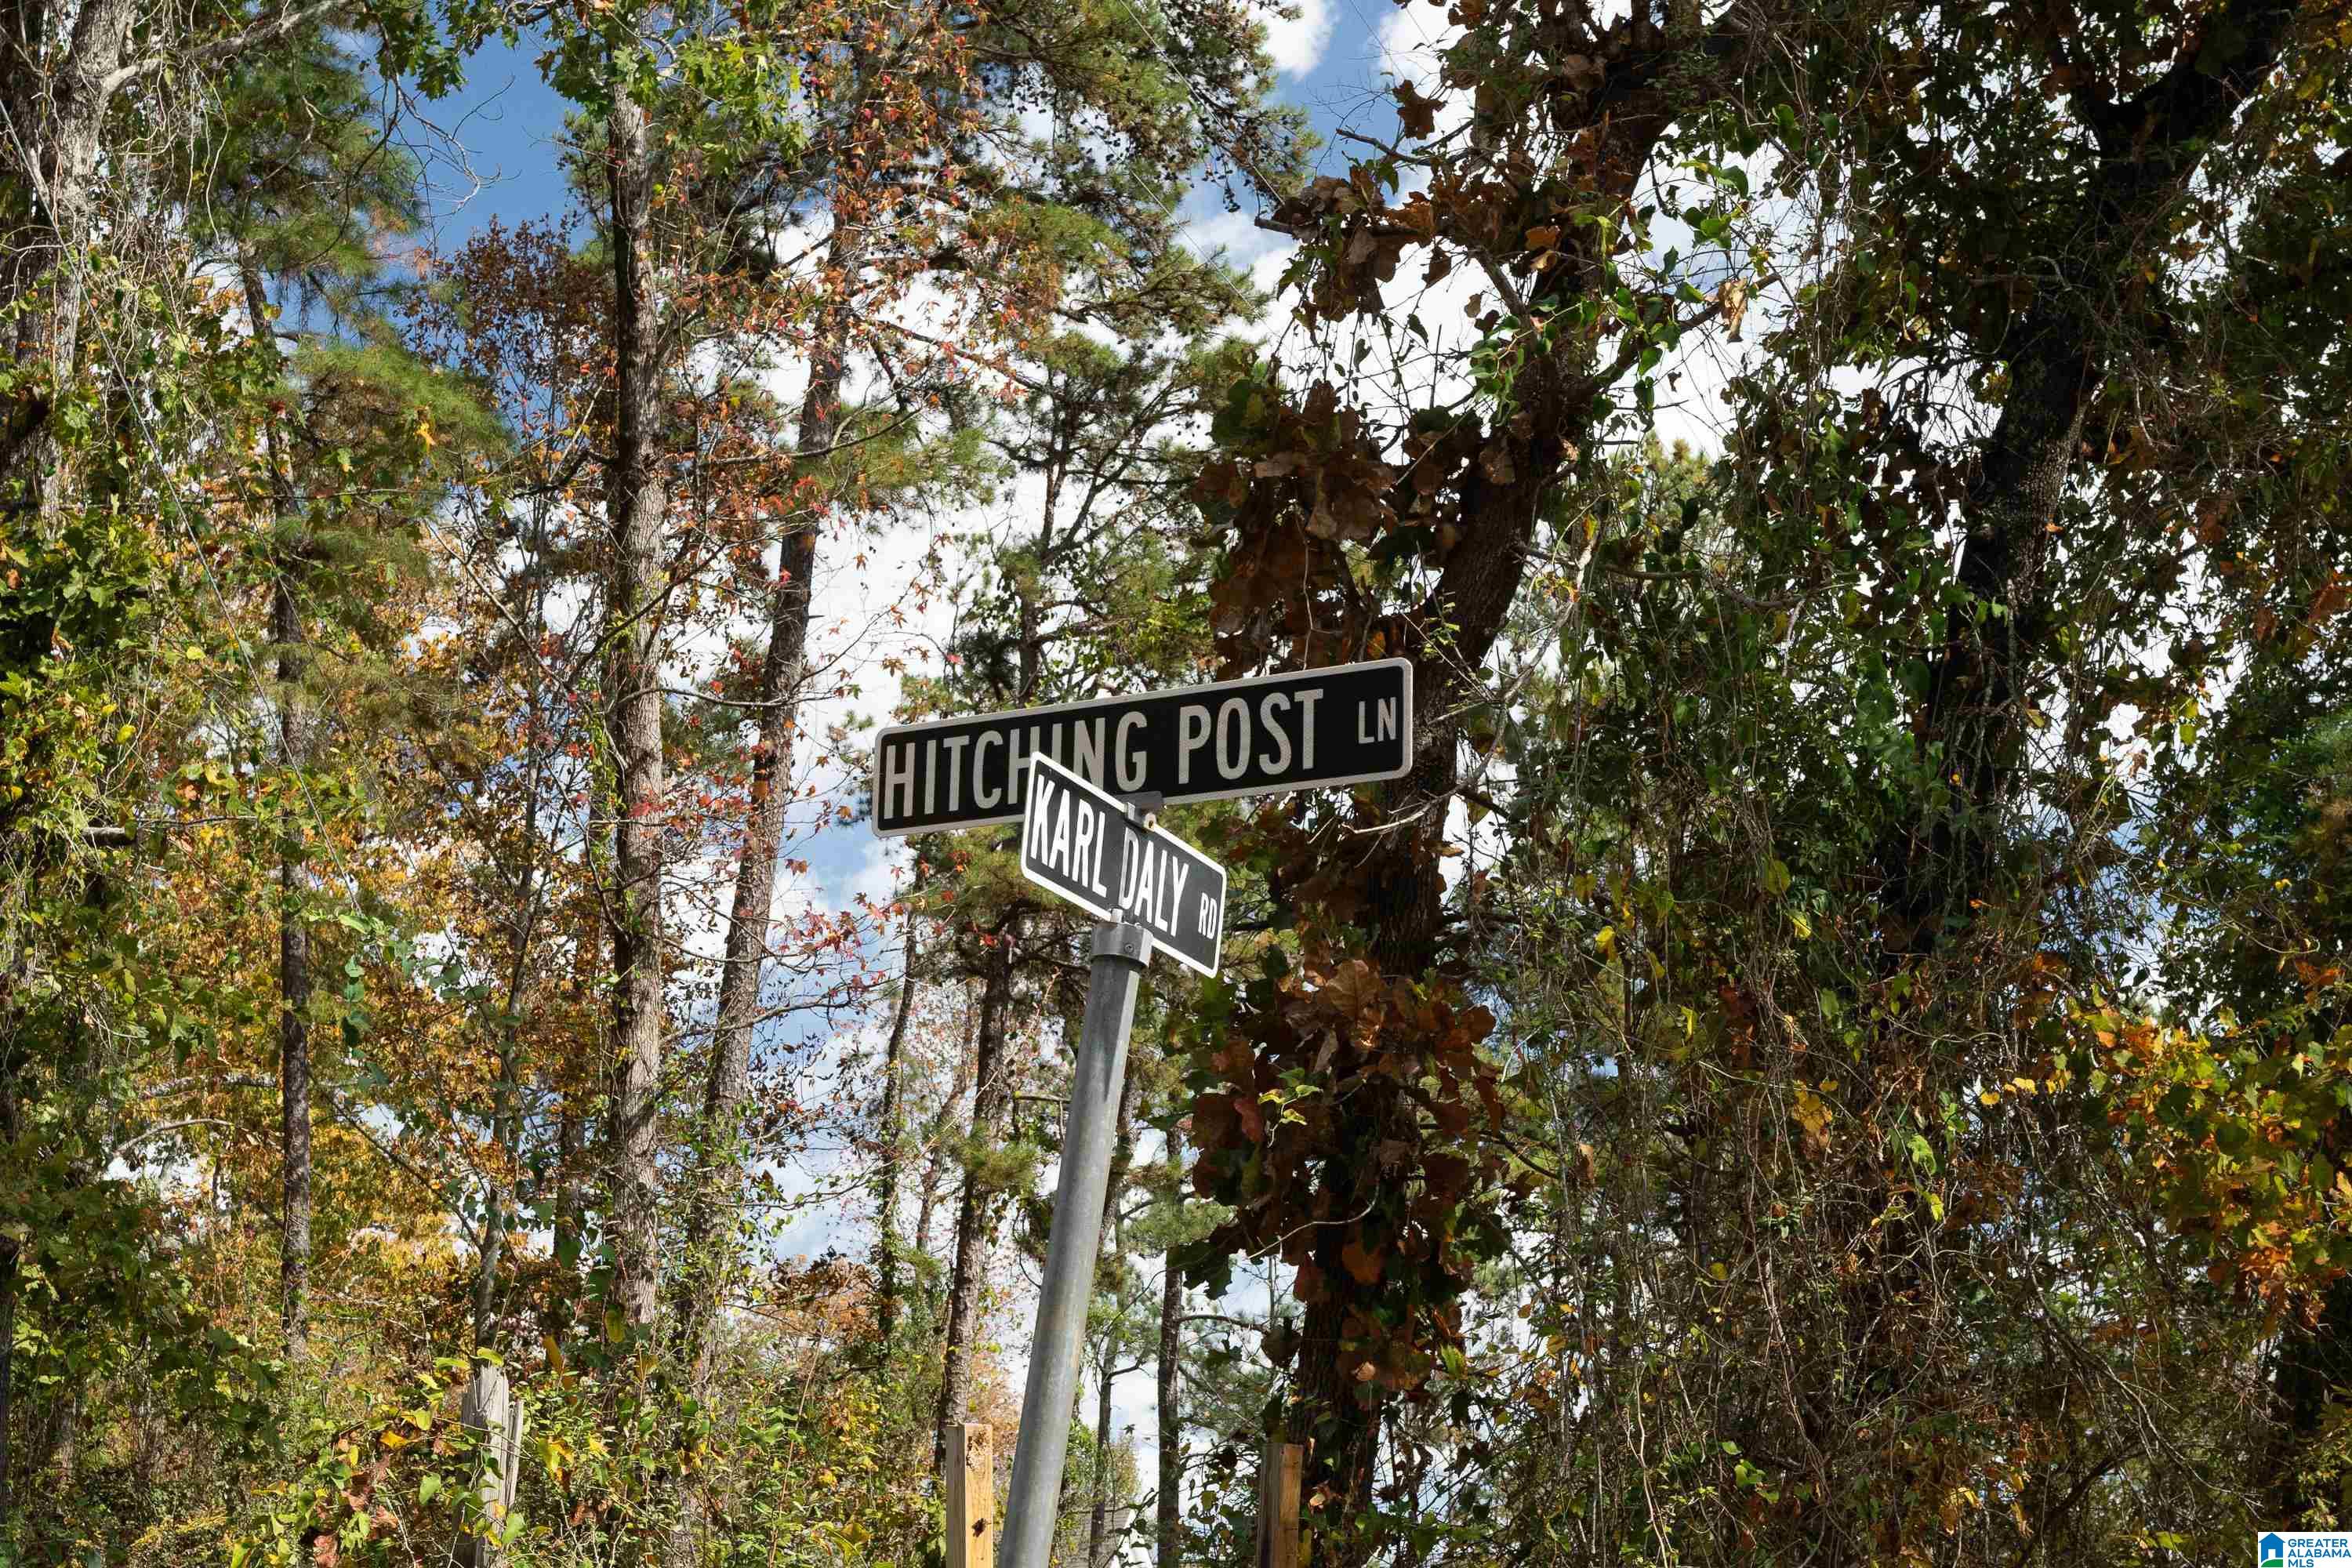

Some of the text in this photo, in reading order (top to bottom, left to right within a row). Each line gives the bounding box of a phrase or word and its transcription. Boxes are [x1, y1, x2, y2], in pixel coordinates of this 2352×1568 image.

[1178, 688, 1323, 784] POST
[1358, 697, 1396, 744] LN
[1030, 774, 1217, 939] KARL DALY RD
